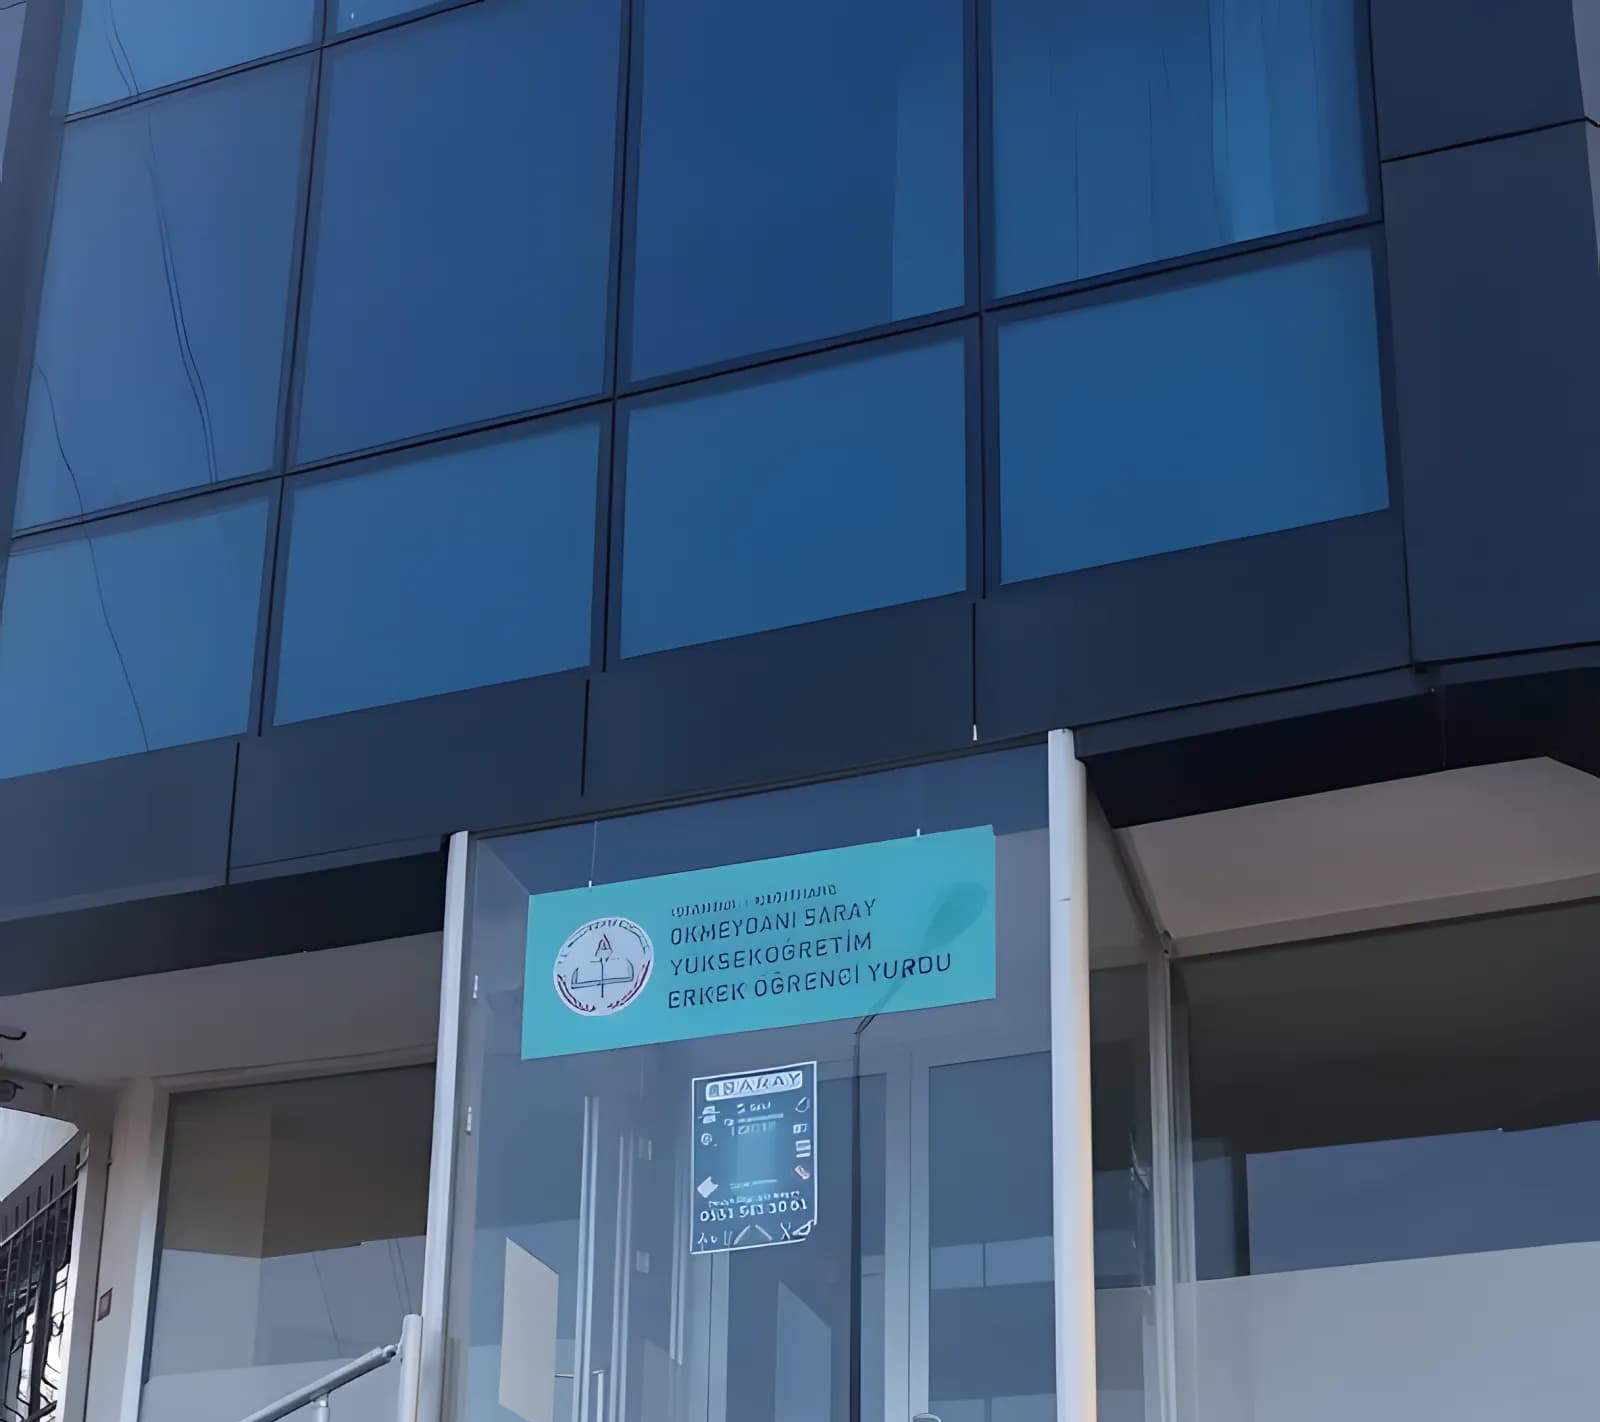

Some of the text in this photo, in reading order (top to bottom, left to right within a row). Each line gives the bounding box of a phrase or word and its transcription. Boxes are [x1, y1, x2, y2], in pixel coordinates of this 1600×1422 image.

[804, 898, 877, 928] SARAY
[668, 981, 746, 1009] ERKEK
[867, 952, 952, 981] YURDU
